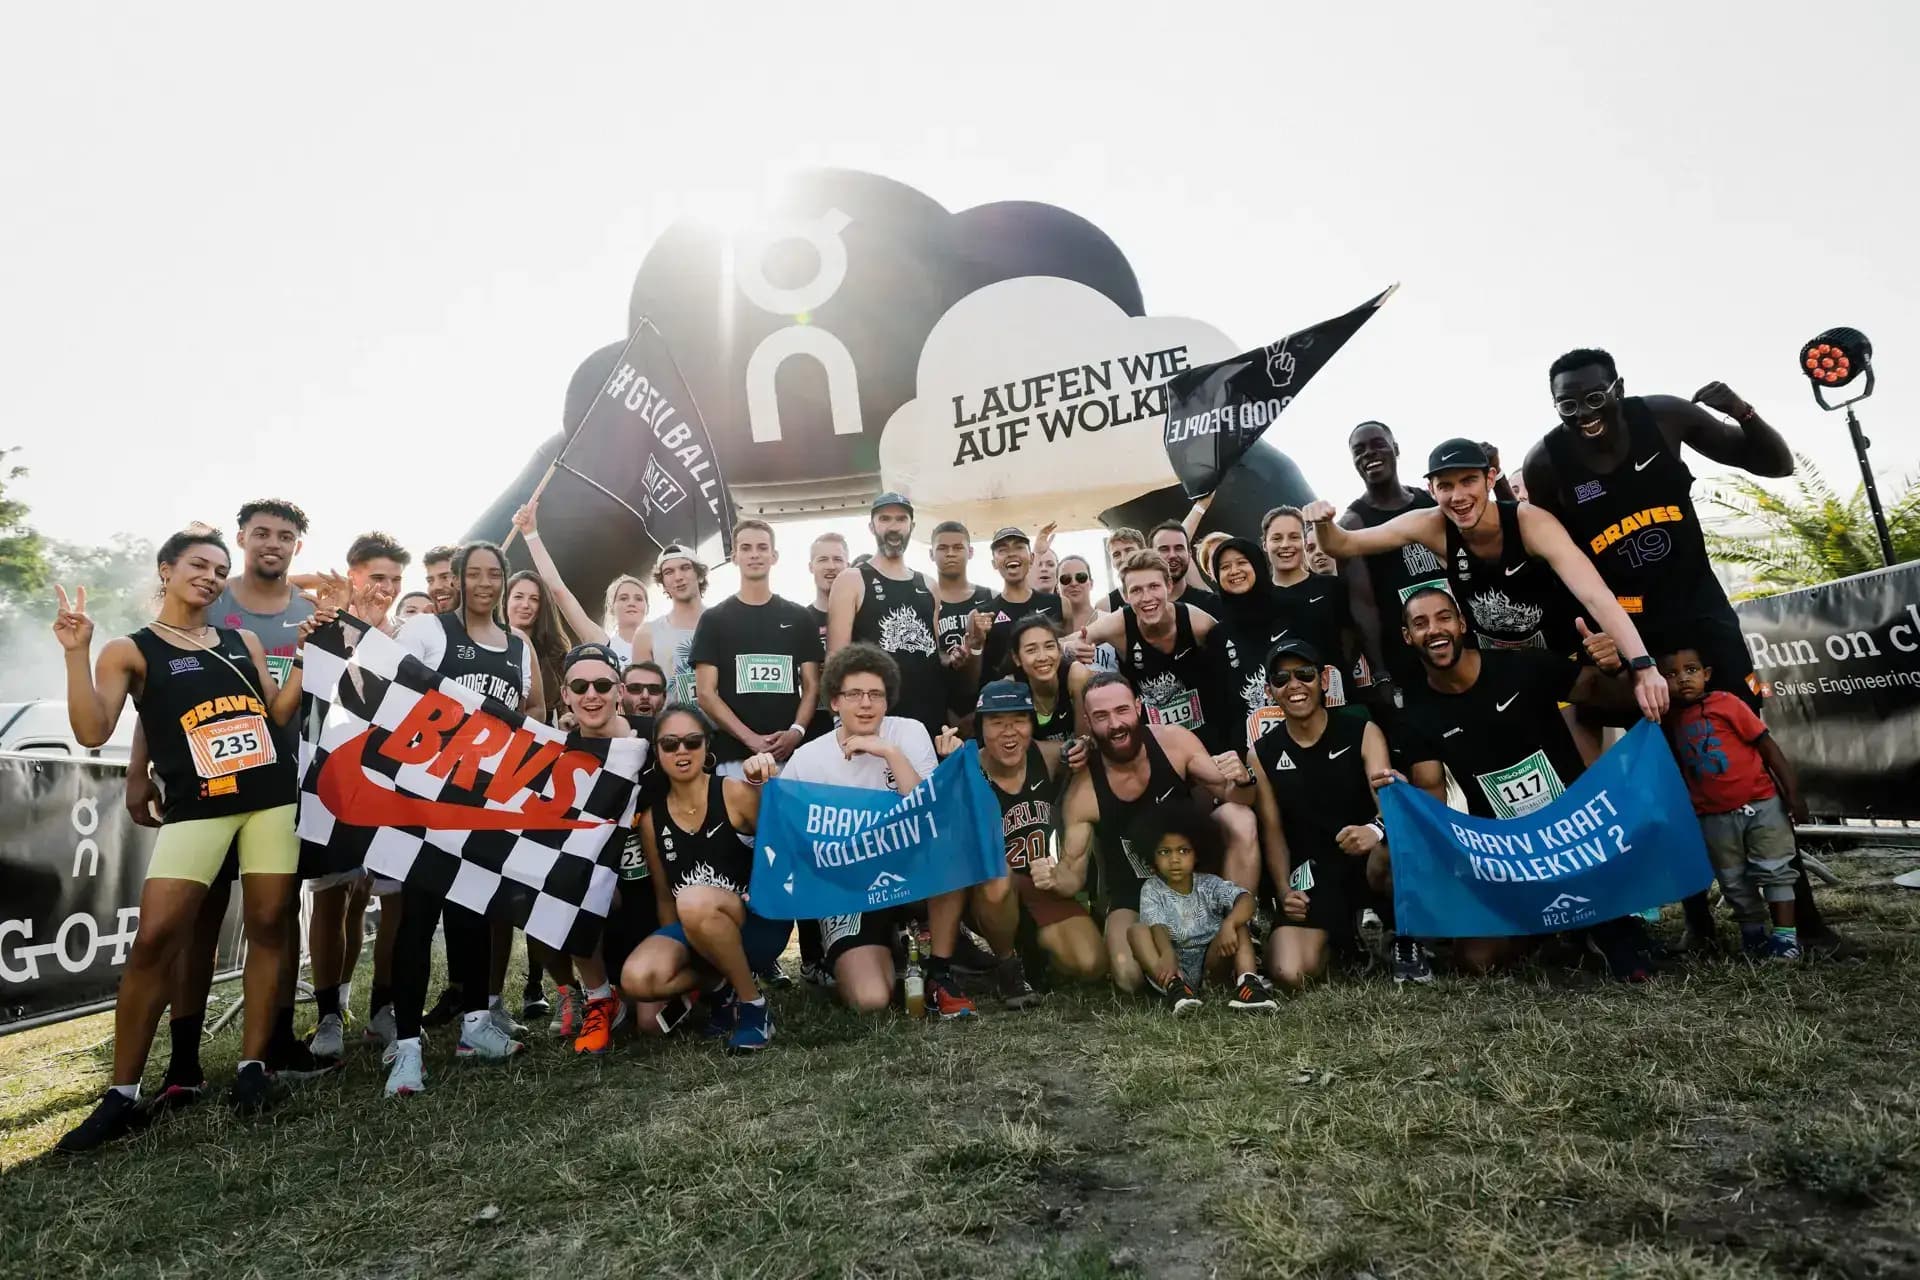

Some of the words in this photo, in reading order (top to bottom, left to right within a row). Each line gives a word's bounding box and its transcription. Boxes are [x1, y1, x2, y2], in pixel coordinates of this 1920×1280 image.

[952, 360, 1111, 429] LAUFEN
[1118, 345, 1191, 385] WIE
[953, 416, 1029, 467] AUF
[1590, 505, 1684, 555] BRAVES
[1617, 527, 1672, 568] 19
[1745, 632, 1820, 670] Run
[1826, 630, 1881, 661] on
[488, 675, 509, 701] THE
[750, 666, 781, 681] 129
[1774, 679, 1817, 697] Swiss
[1818, 669, 1920, 695] Engineering
[1162, 705, 1191, 726] 119
[211, 732, 258, 759] 235
[378, 688, 602, 815] BRVS
[1502, 773, 1541, 804] 117
[806, 803, 881, 837] BRAYV
[1001, 800, 1052, 837] ERLIN
[1450, 821, 1534, 855] BRAYV
[1537, 789, 1617, 850] KRAFT
[813, 815, 921, 869] KOLLEKTIV
[924, 811, 939, 839] 1
[1004, 828, 1046, 868] 20
[1469, 837, 1608, 883] KOLLEKTIV
[1608, 824, 1632, 854] 2
[1543, 911, 1570, 927] H2C
